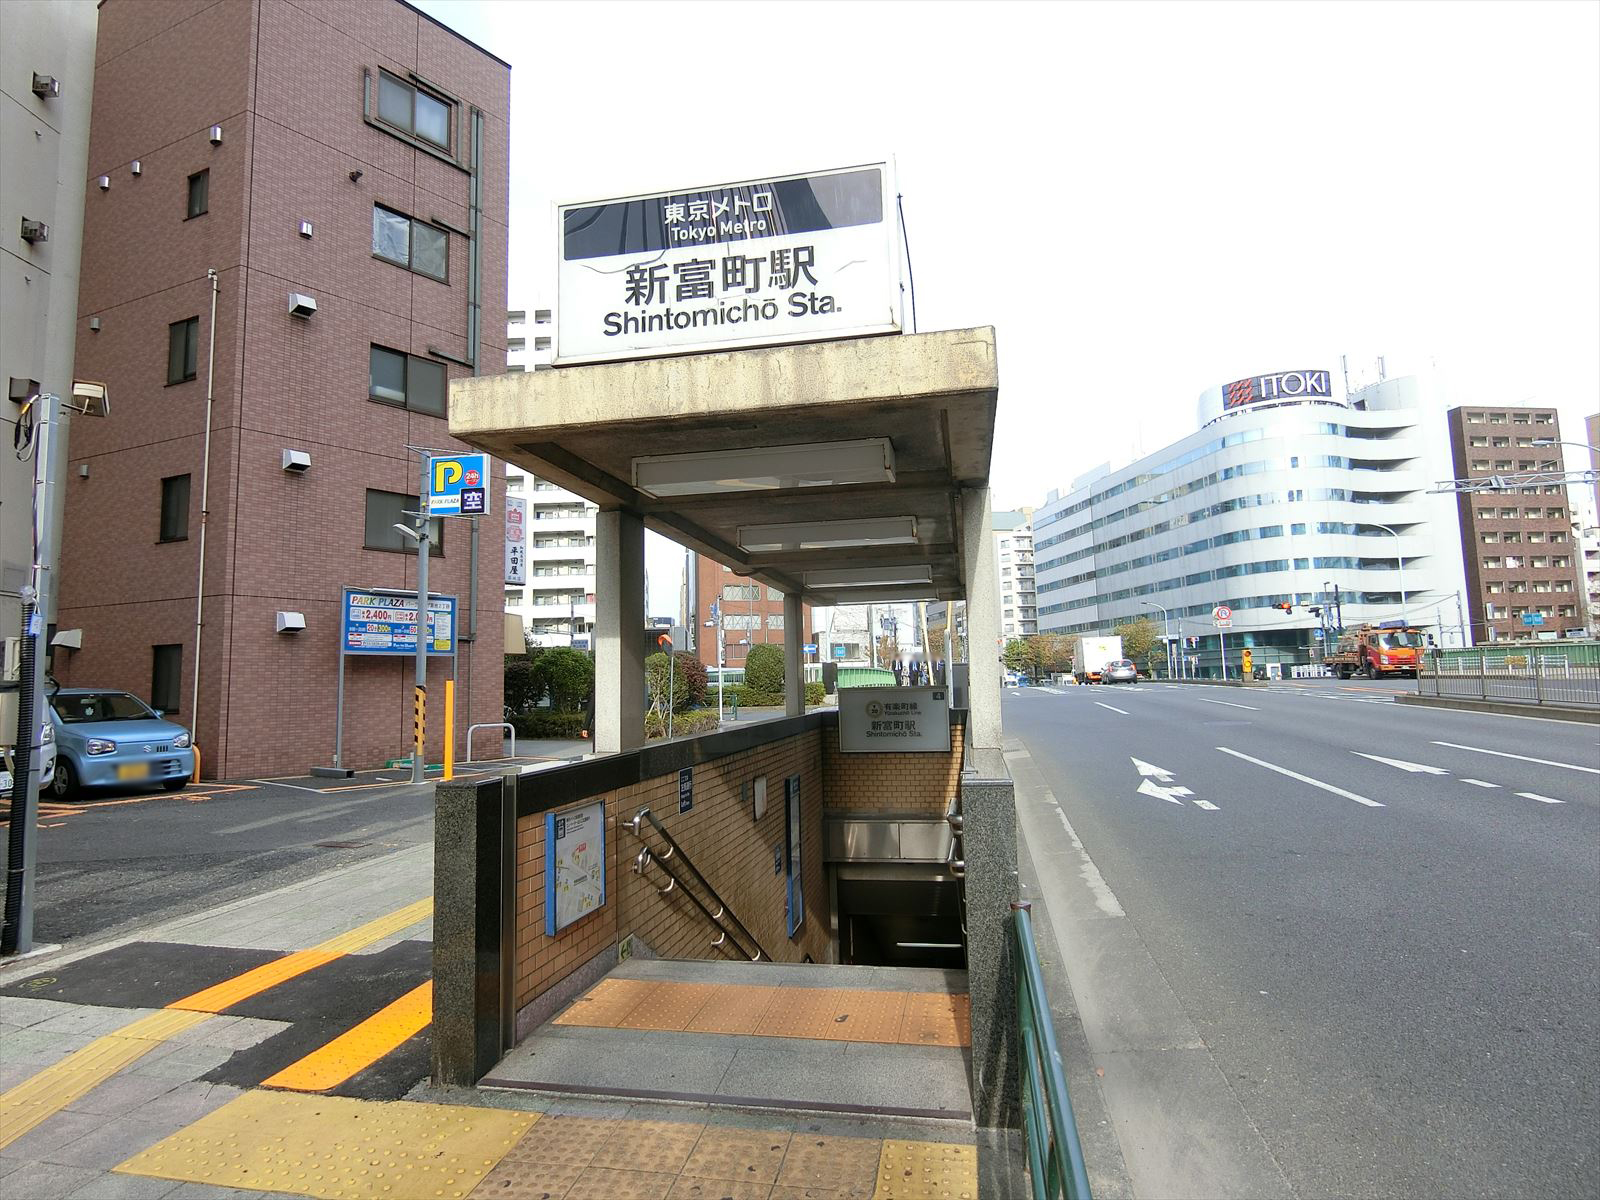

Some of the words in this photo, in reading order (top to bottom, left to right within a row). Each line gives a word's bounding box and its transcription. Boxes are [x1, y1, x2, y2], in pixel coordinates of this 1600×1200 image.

[664, 191, 772, 225] 東京メトロ
[671, 223, 715, 242] Tokyo
[720, 218, 766, 236] Metro
[624, 245, 818, 306] 新富町駅
[603, 298, 779, 338] Shintomichō
[787, 291, 843, 318] Sta.
[1260, 372, 1326, 398] ITOKI
[435, 460, 463, 493] P
[463, 491, 483, 510] 空
[510, 546, 519, 575] 平田屋
[351, 596, 377, 606] PARK
[378, 597, 405, 608] PLAZA
[884, 702, 918, 711] 有楽町線
[871, 720, 916, 731] 新富町駅
